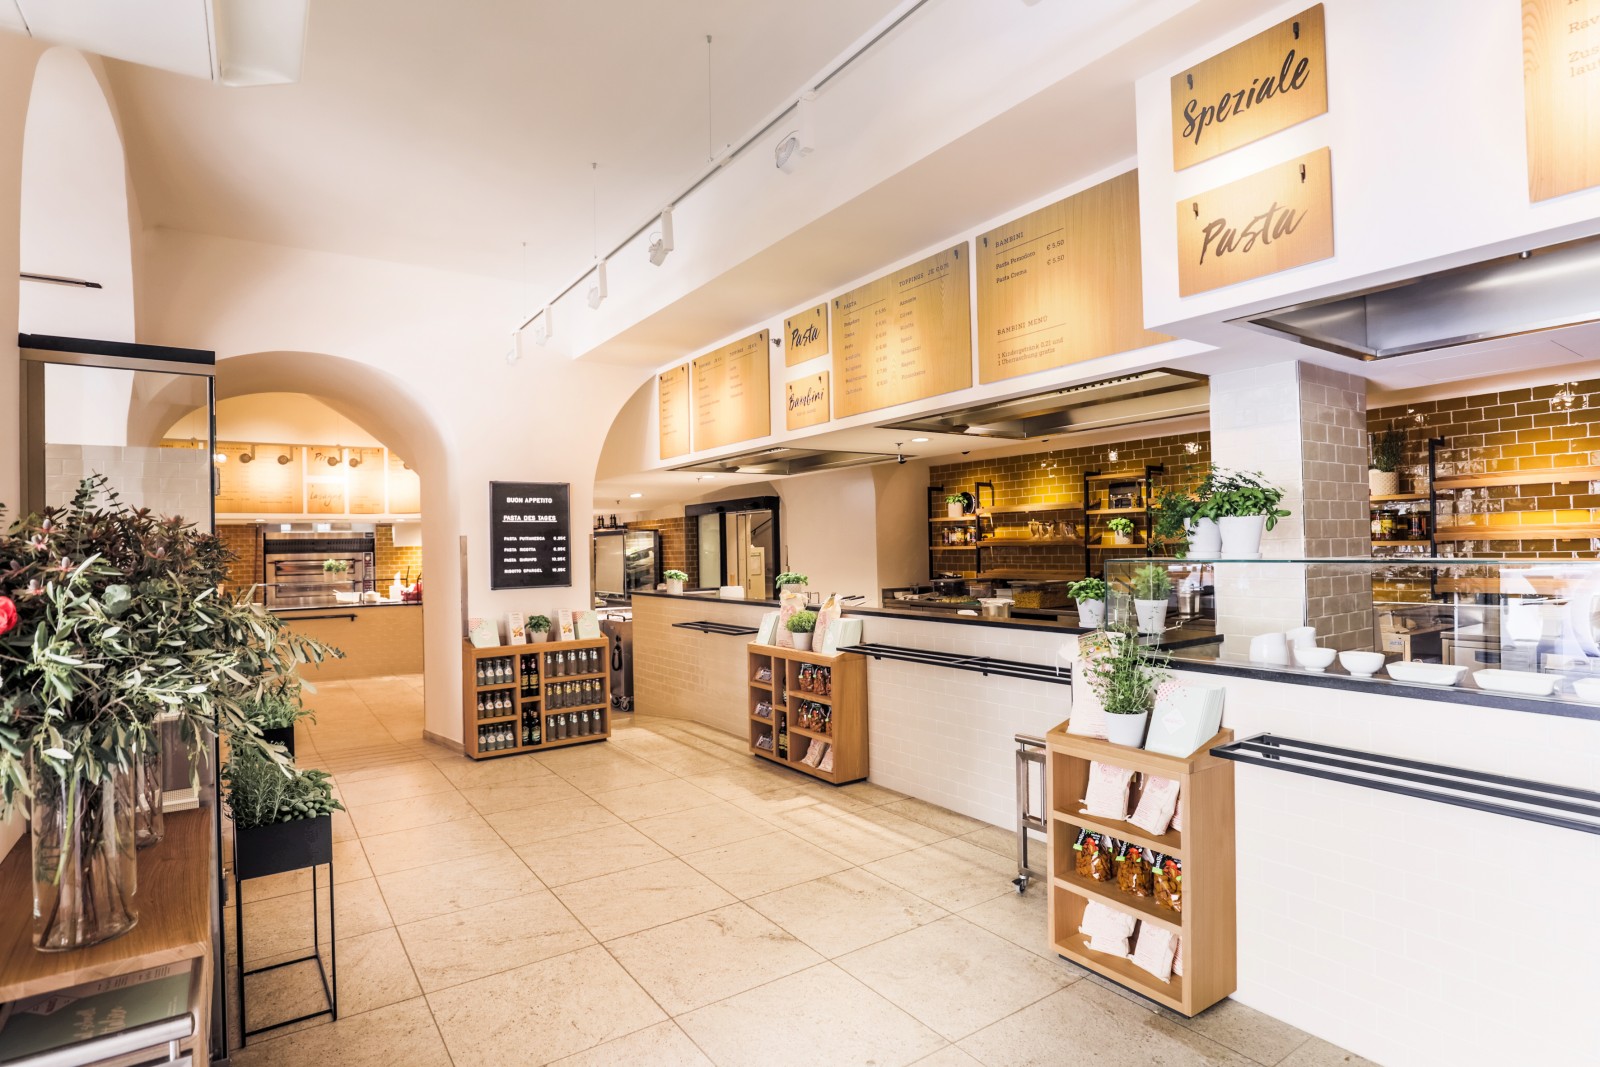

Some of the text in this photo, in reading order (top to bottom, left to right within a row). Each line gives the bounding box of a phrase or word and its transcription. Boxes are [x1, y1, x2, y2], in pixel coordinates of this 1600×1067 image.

[1569, 59, 1600, 77] lau
[1182, 49, 1310, 145] Speziale
[995, 232, 1024, 248] BAMBINI
[1199, 201, 1308, 265] Pasta
[996, 261, 1010, 270] Pasta
[898, 272, 924, 287] TOPPINGS
[996, 275, 1010, 284] Pasta
[790, 323, 820, 350] Pasta
[997, 322, 1026, 336] BAMBINI
[789, 387, 824, 411] Bambini
